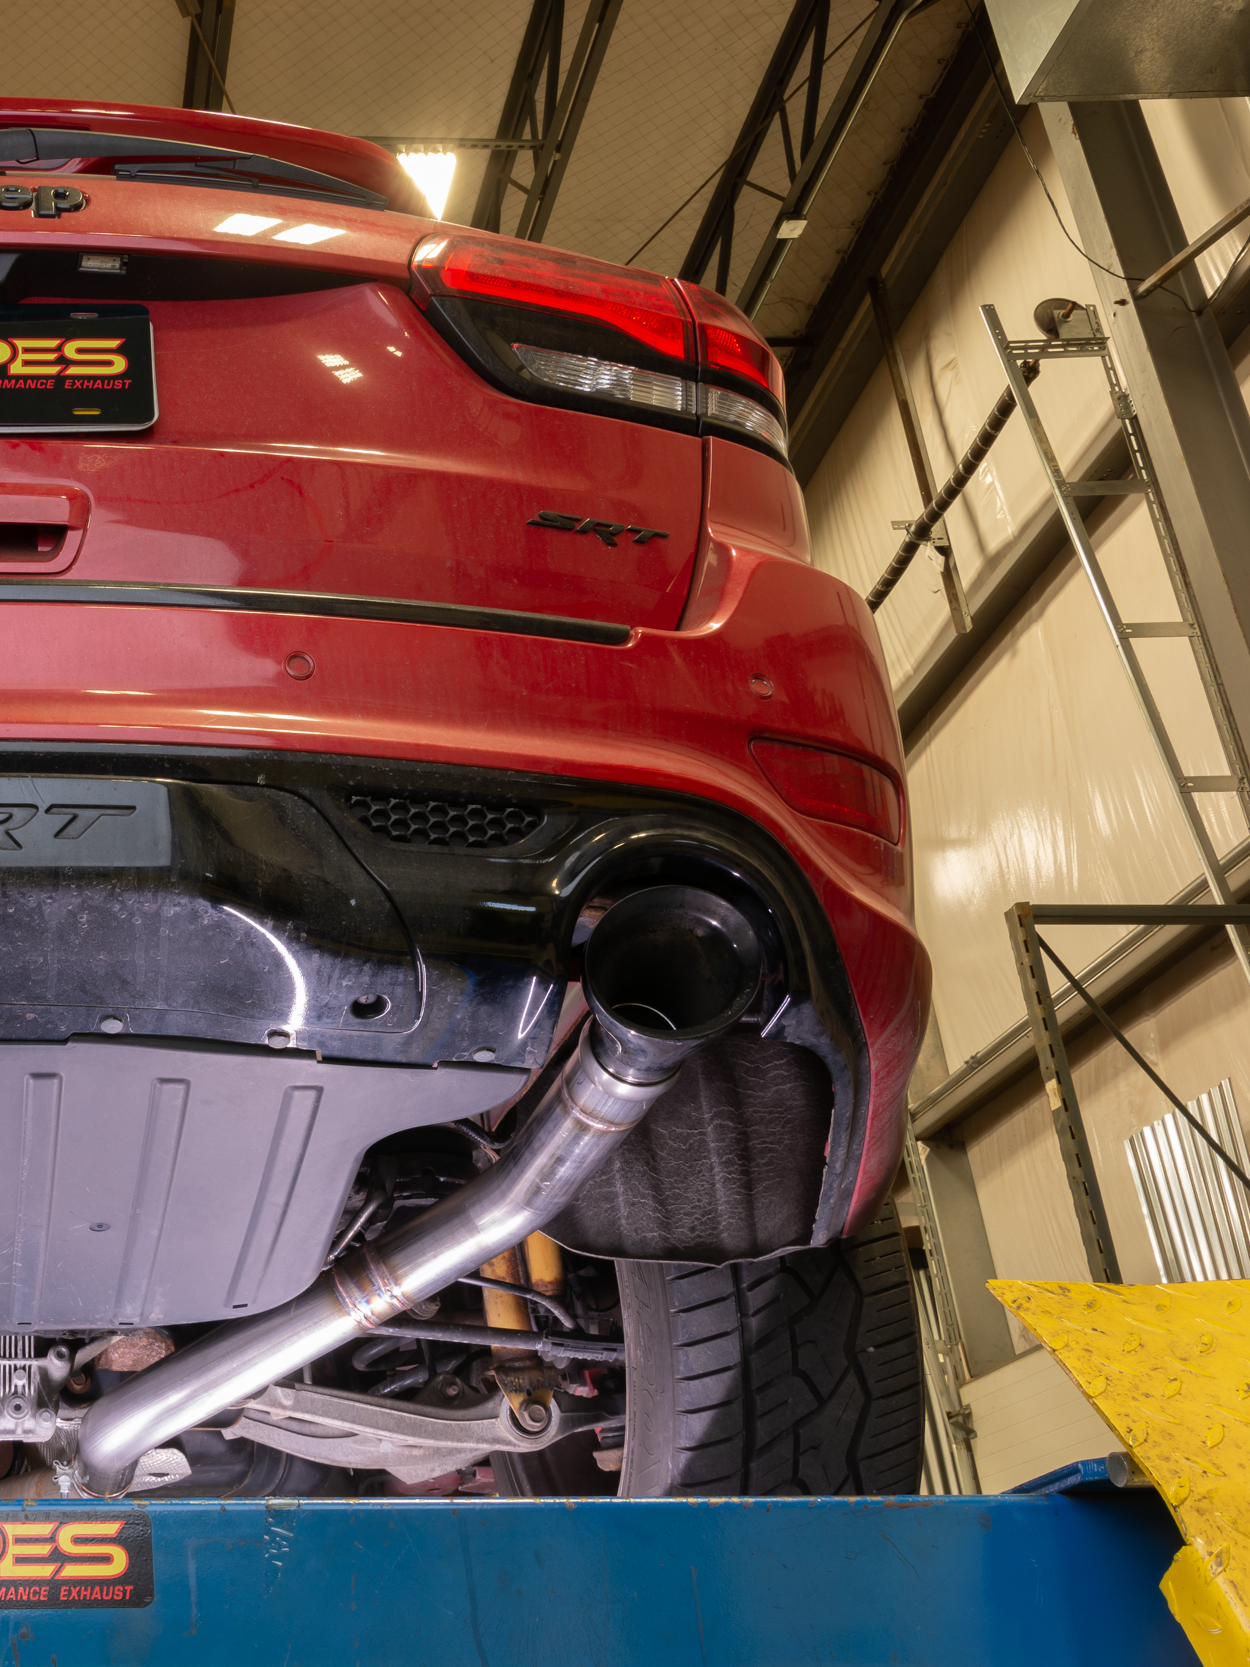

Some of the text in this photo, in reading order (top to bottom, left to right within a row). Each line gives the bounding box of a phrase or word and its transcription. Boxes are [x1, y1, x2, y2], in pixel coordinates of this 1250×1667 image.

[64, 379, 132, 390] EXHAUST
[526, 510, 670, 546] SRT
[60, 1585, 134, 1600] EXHAUST
